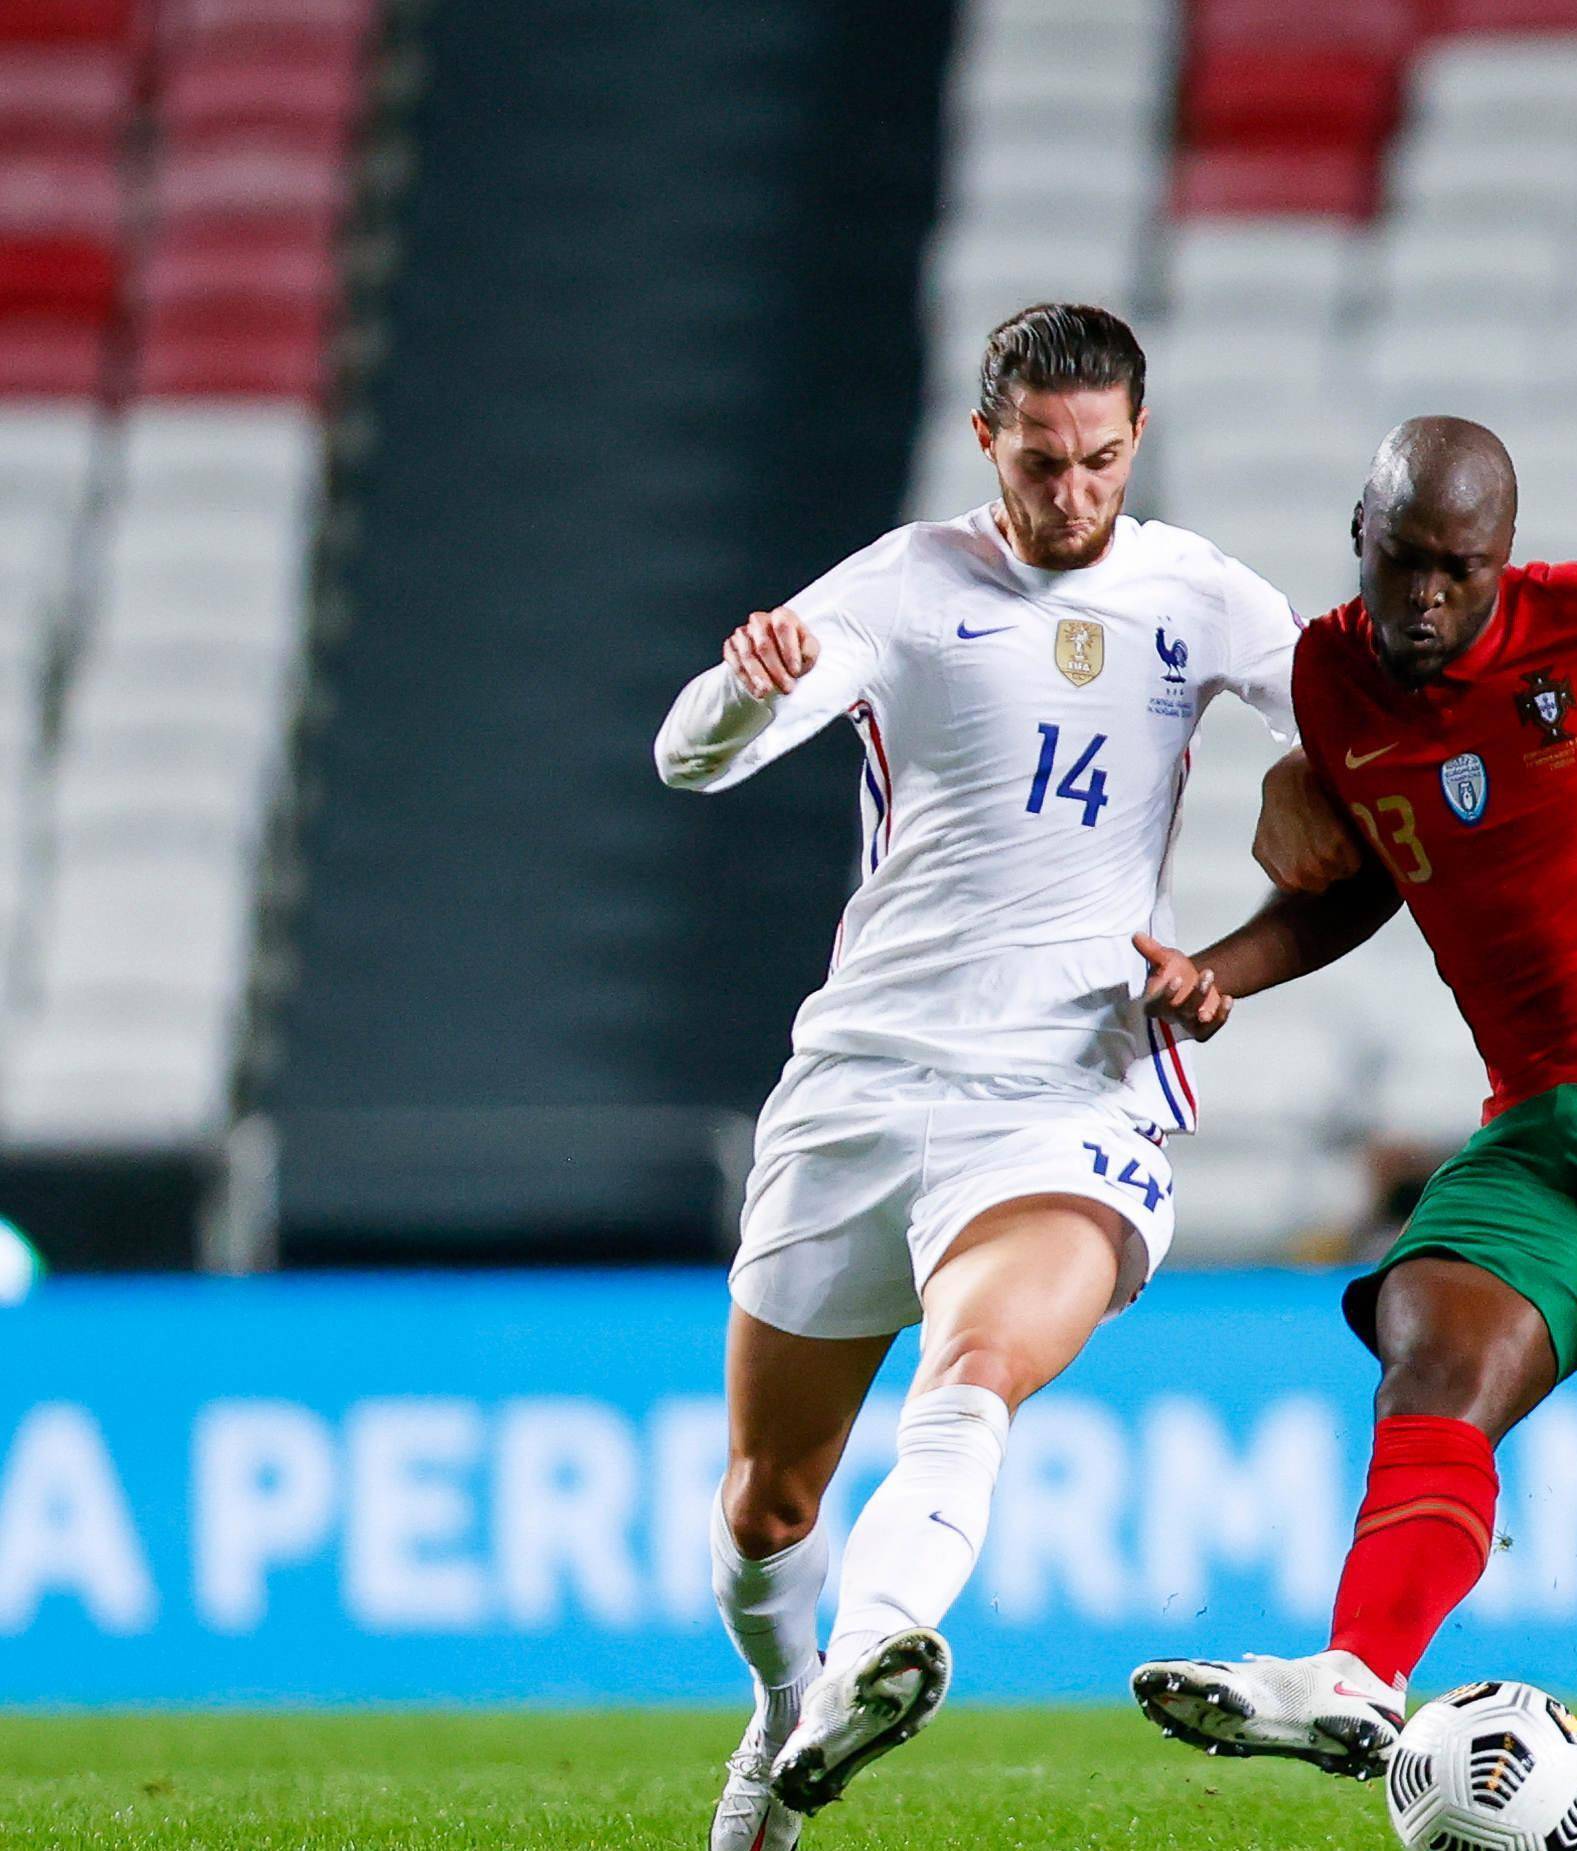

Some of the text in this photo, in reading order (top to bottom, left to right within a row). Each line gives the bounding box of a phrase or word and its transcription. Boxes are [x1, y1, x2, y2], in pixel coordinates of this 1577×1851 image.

[1025, 722, 1109, 827] 14
[1351, 795, 1433, 883] 13
[1082, 1140, 1165, 1213] 14
[0, 1398, 161, 1636] A
